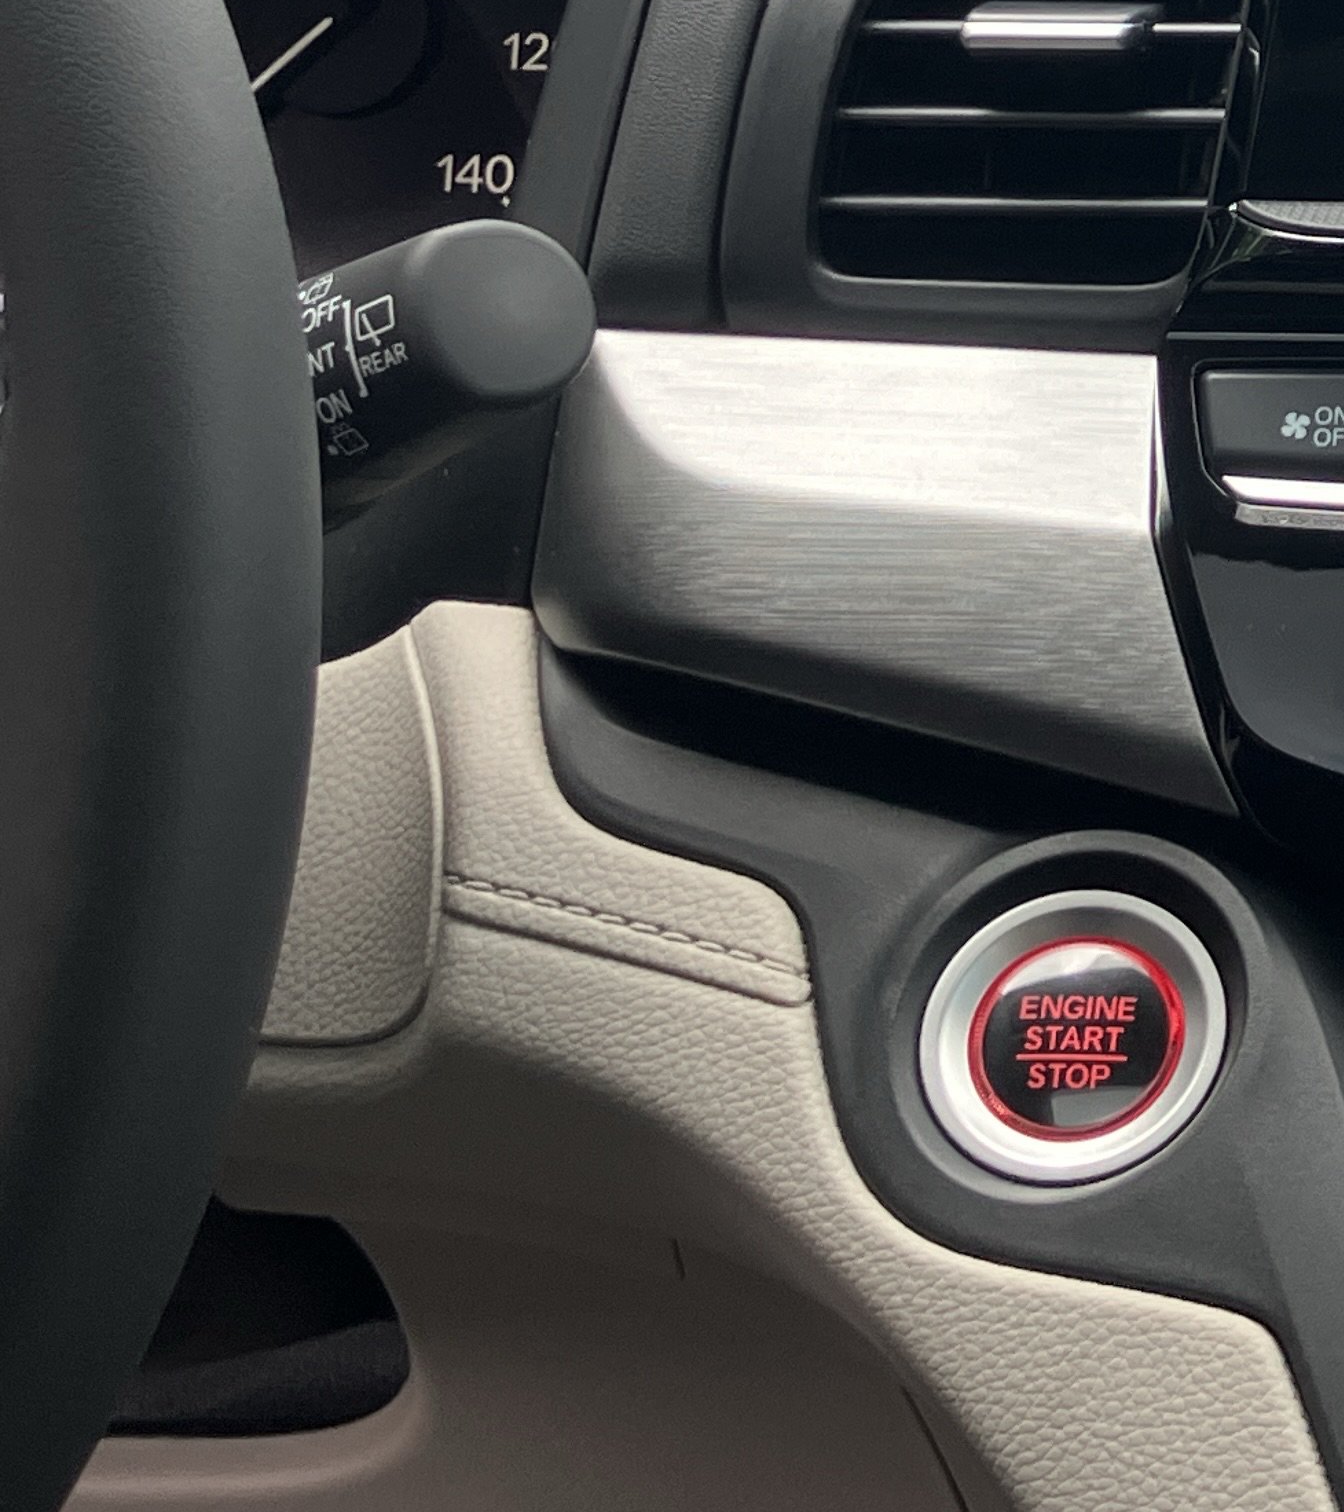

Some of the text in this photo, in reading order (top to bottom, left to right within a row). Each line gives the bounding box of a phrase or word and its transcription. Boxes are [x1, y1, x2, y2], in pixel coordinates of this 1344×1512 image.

[503, 32, 549, 71] 12
[437, 154, 514, 194] 140
[307, 341, 335, 377] NT
[358, 341, 409, 377] REAR
[315, 389, 352, 424] ON
[1018, 995, 1138, 1021] ENGINE
[1023, 1025, 1124, 1052] START
[1026, 1062, 1111, 1089] STOP
